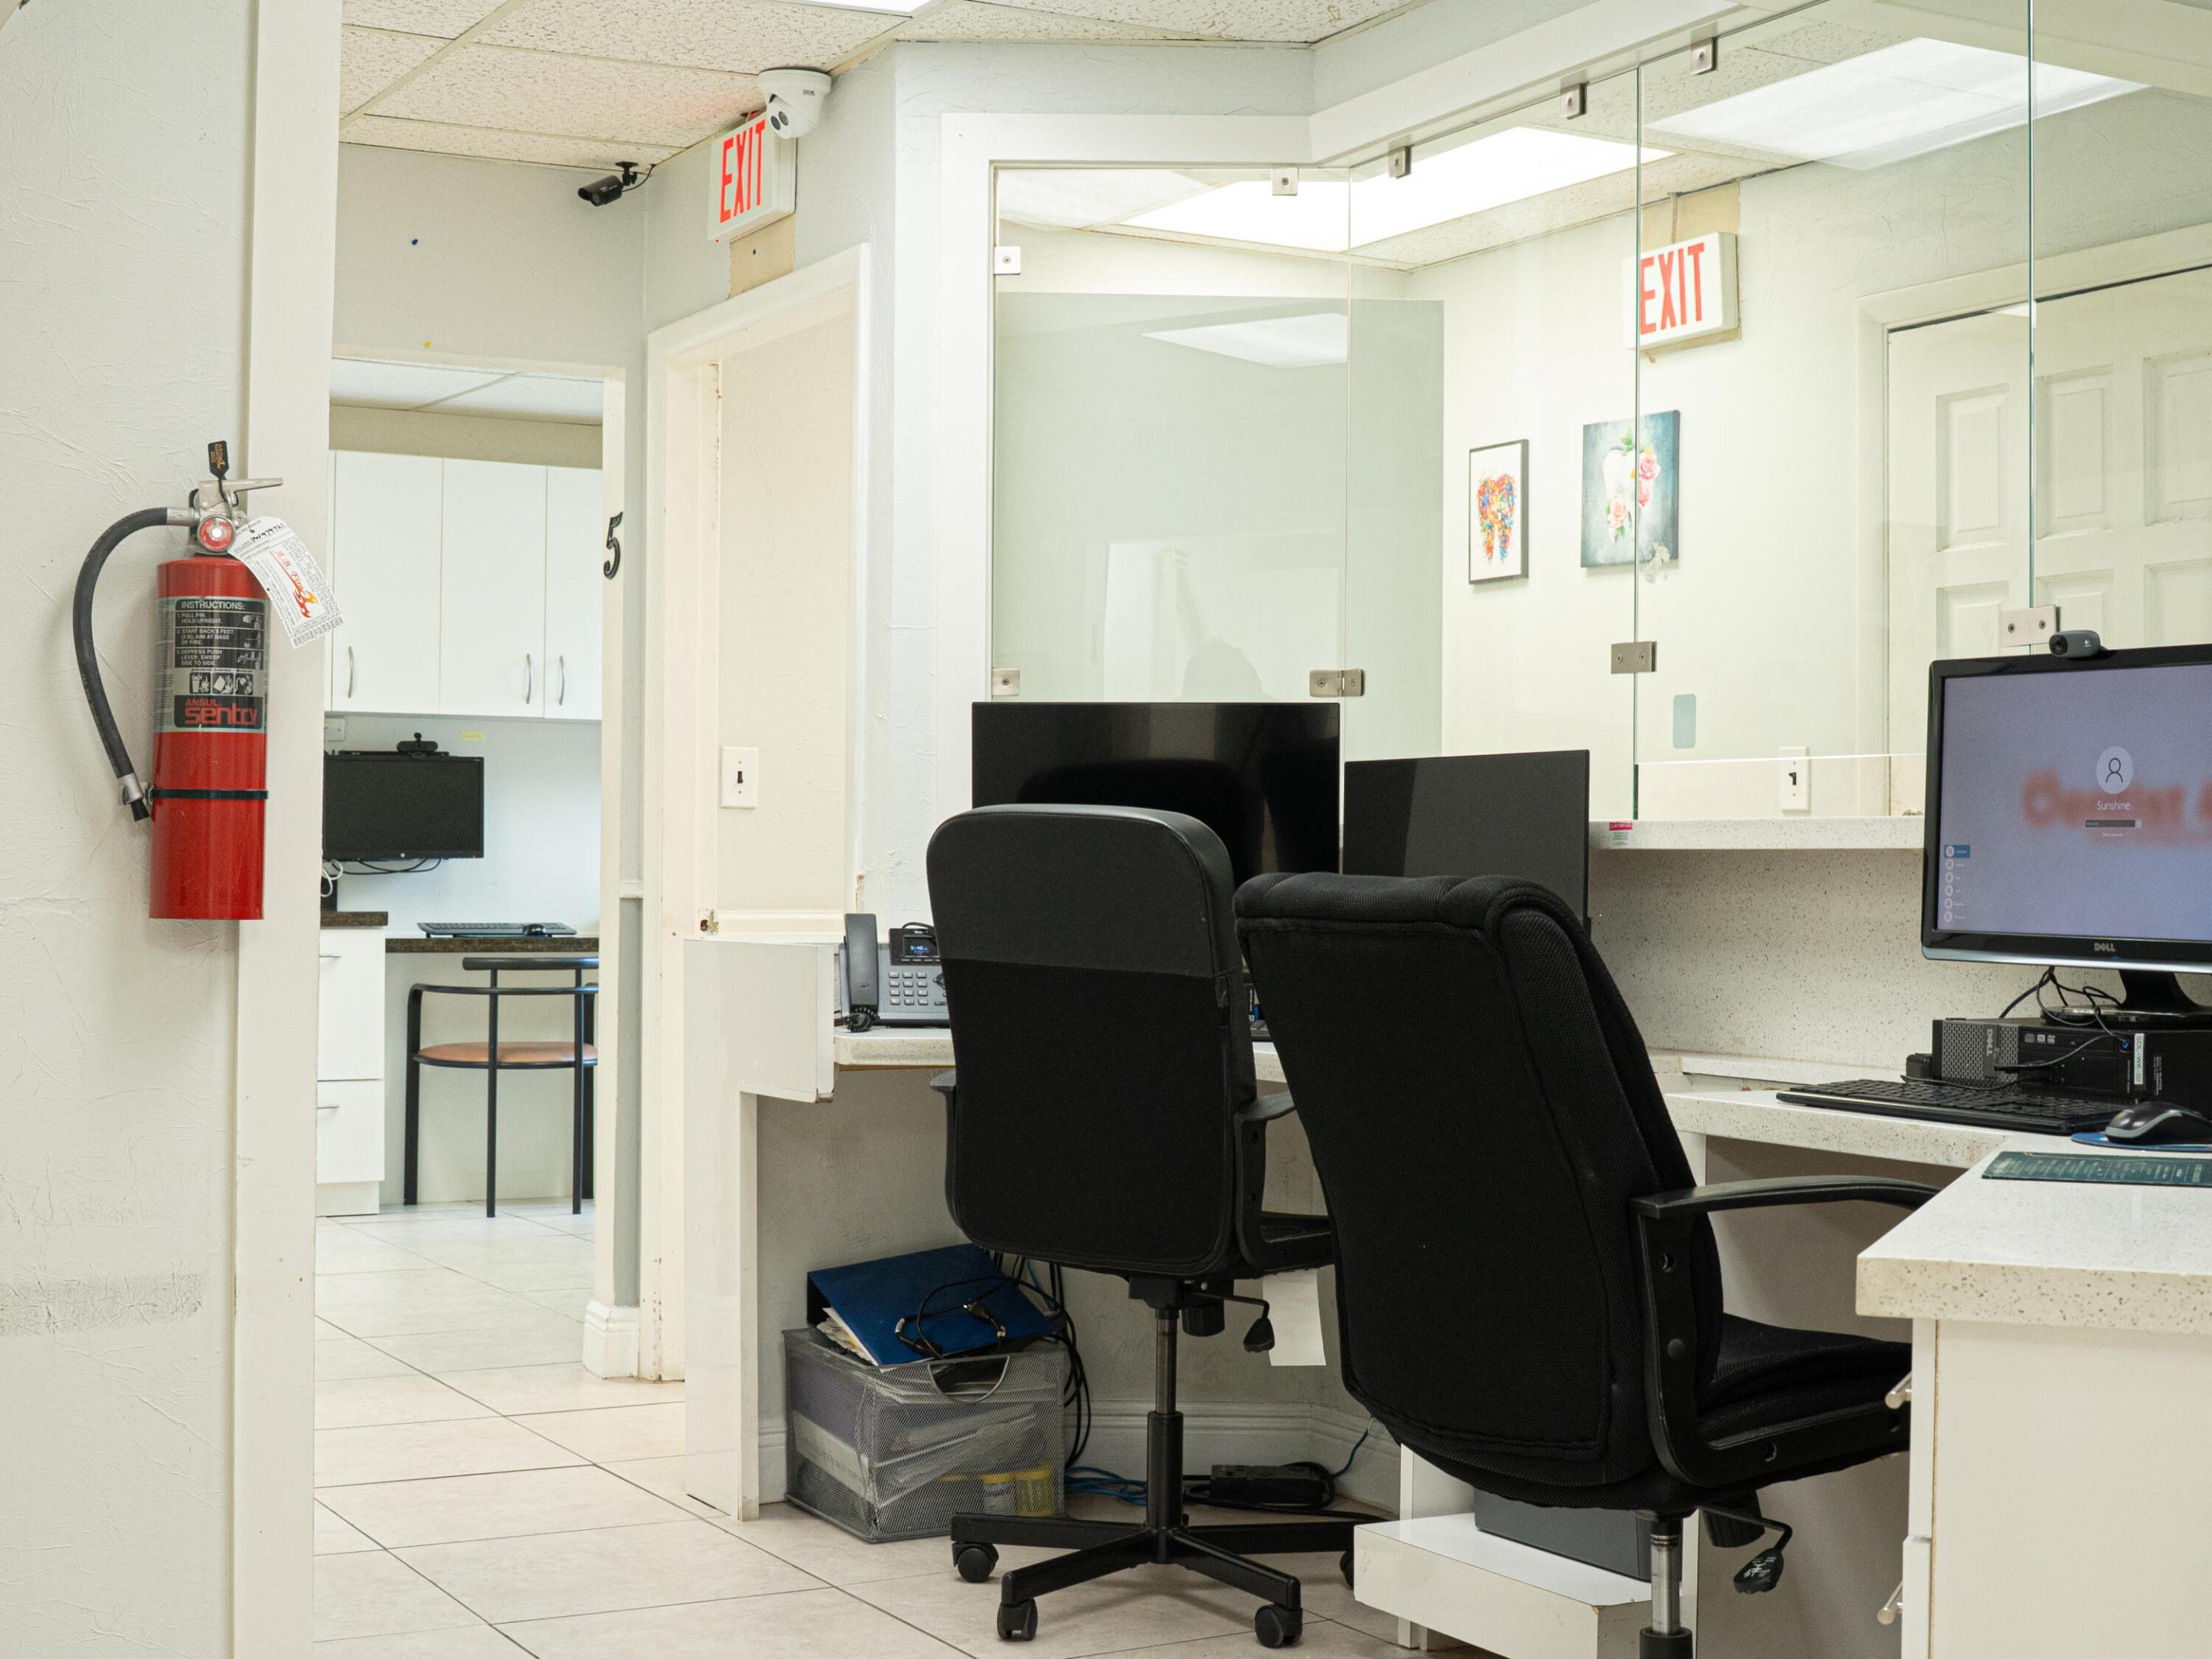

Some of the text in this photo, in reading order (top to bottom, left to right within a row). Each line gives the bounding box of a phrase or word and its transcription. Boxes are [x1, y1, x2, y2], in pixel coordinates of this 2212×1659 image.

[720, 118, 766, 224] EXIT
[1641, 242, 1704, 335] EXIT
[604, 512, 623, 580] 5
[181, 601, 245, 610] INSTRUCTIONS:
[184, 702, 258, 725] sentry
[2097, 800, 2131, 810] Sunshine
[2094, 942, 2116, 952] DELL
